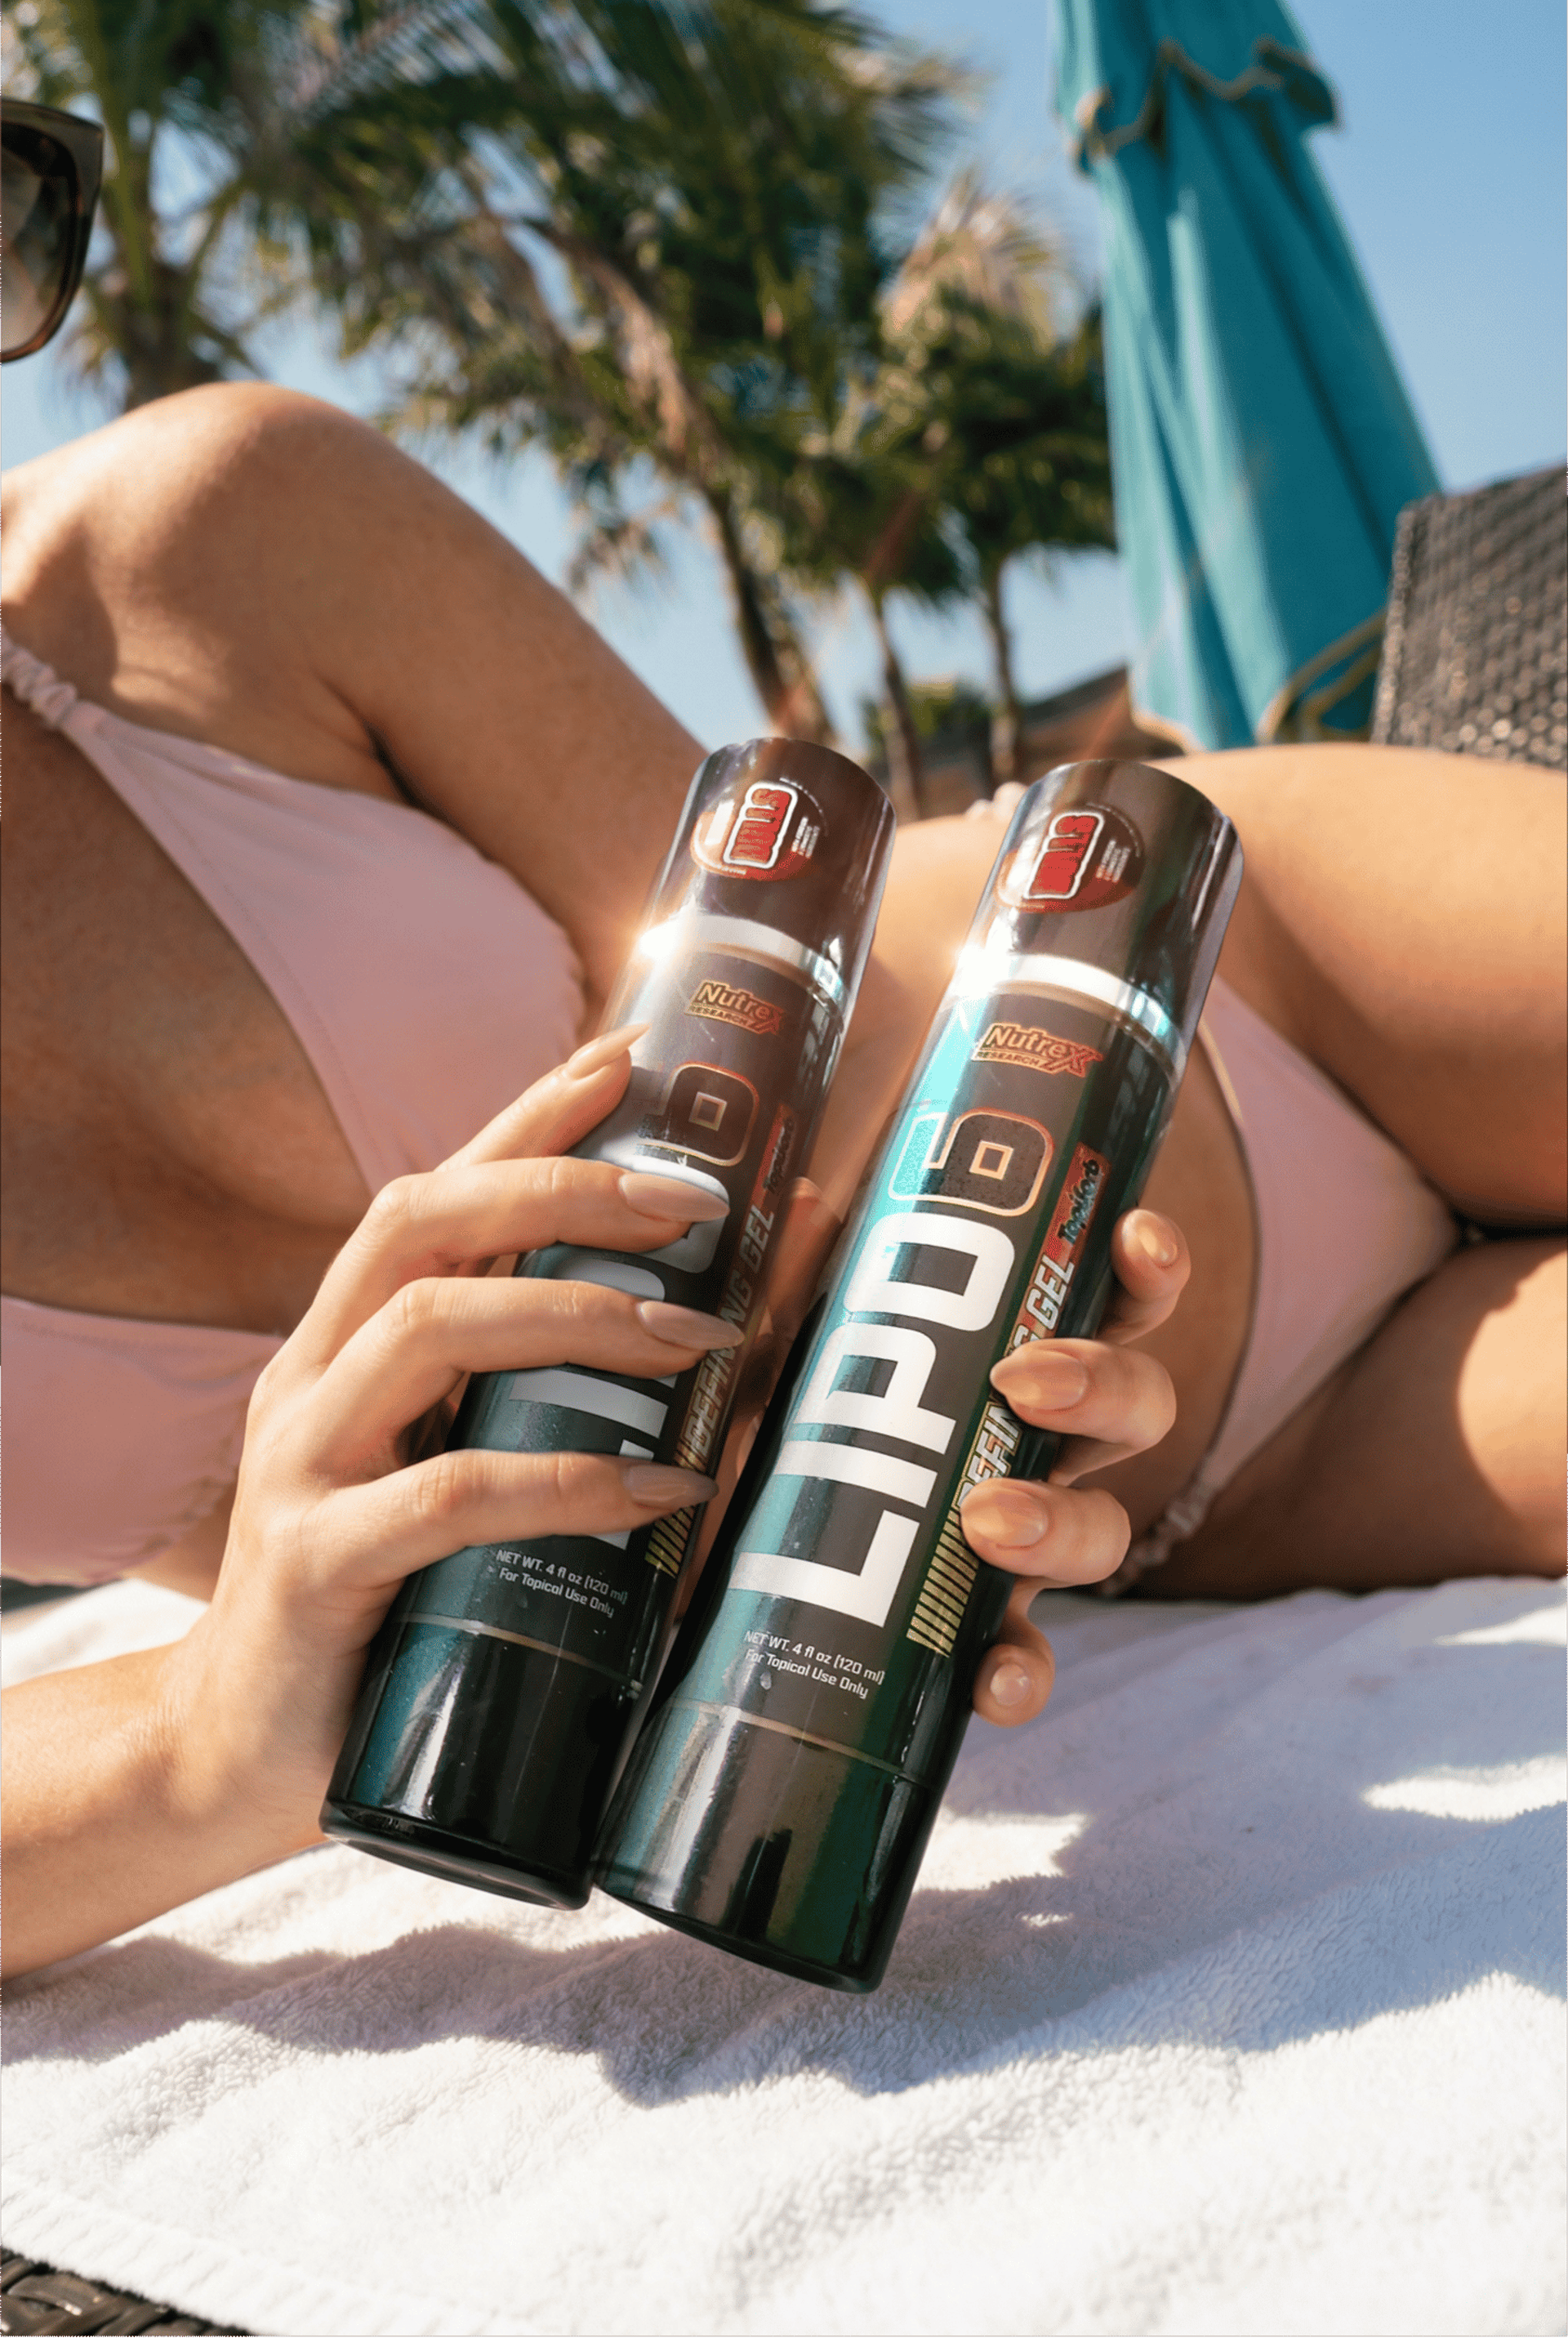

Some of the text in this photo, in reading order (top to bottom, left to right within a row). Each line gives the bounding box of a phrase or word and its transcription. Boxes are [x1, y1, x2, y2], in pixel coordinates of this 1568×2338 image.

[976, 1051, 1040, 1067] RESEARCH
[1026, 1254, 1076, 1331] GEL
[684, 1204, 775, 1458] DEFINNG GEL
[496, 1549, 522, 1565] NET
[522, 1555, 543, 1573] WT.
[546, 1564, 555, 1576] 4
[558, 1566, 567, 1579] fl
[568, 1572, 583, 1585] oz
[498, 1567, 615, 1619] For Topical Use Only
[743, 1630, 769, 1646] NET
[768, 1635, 791, 1653] WT.
[792, 1643, 802, 1656] 4
[804, 1644, 815, 1660] fl
[815, 1651, 833, 1665] oz
[744, 1648, 870, 1700] For Topical Use Only
